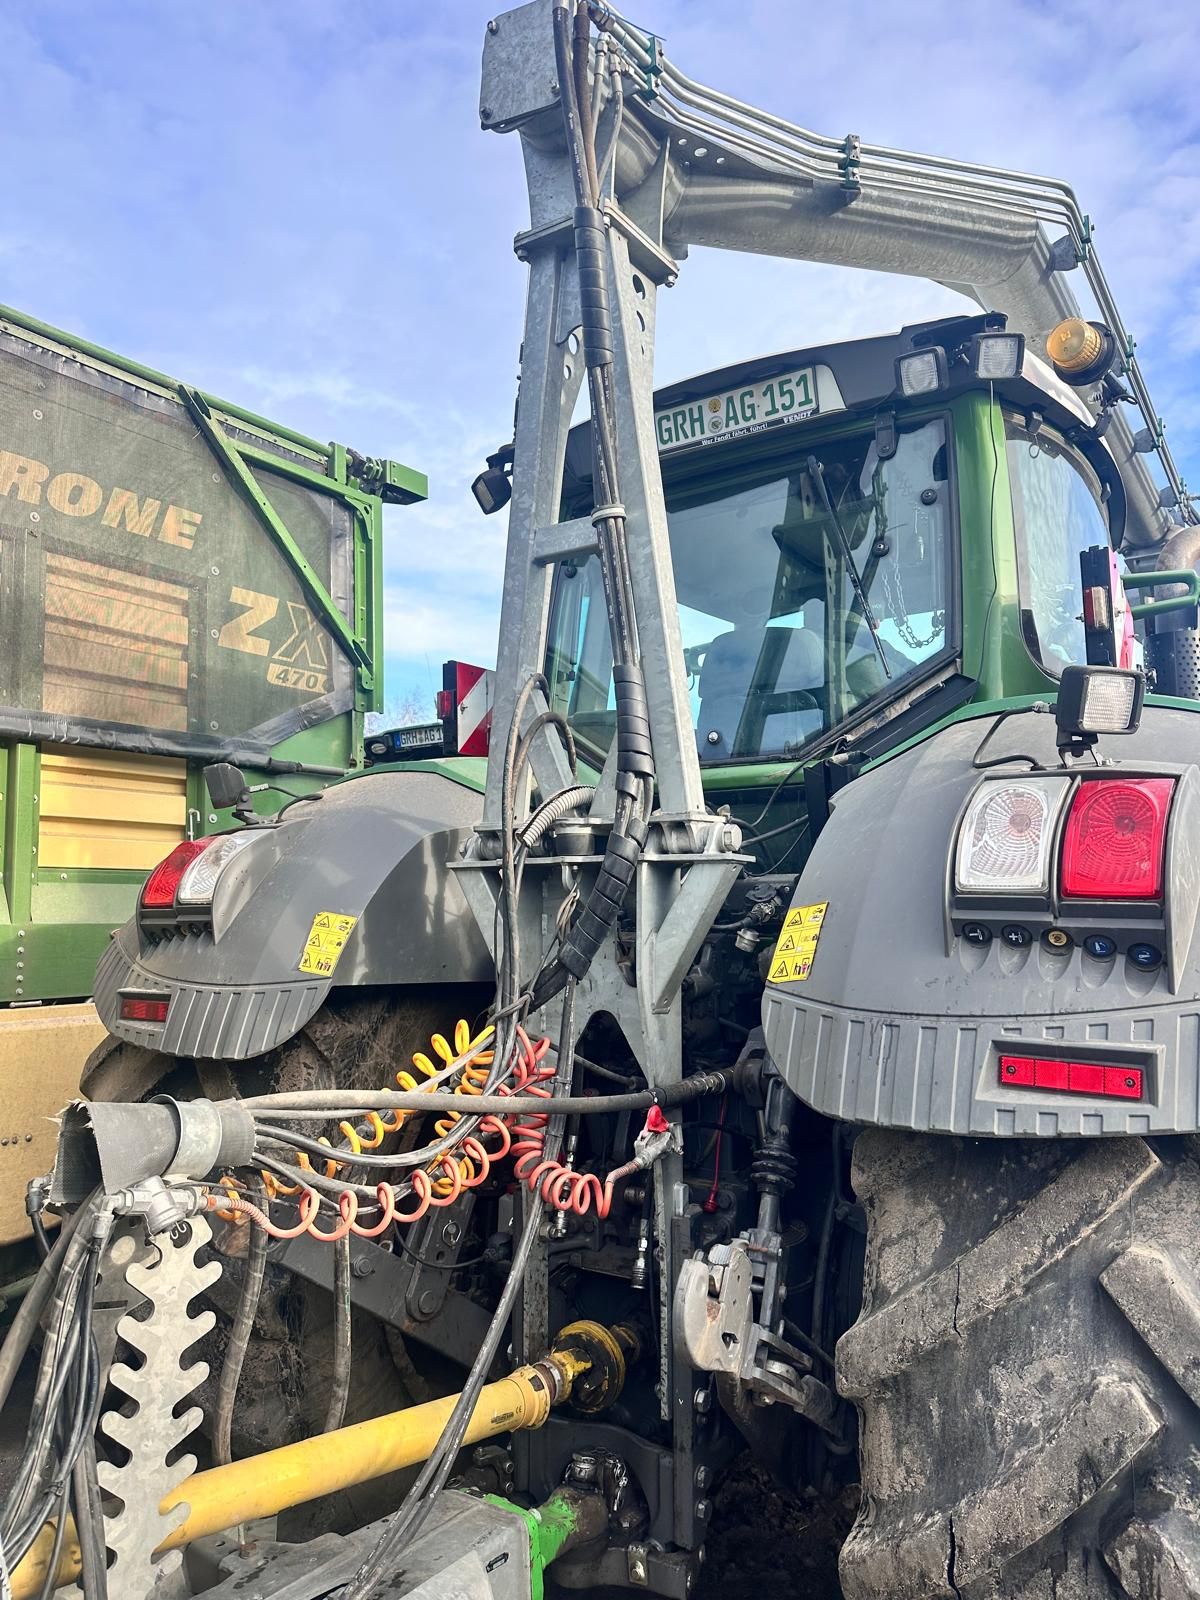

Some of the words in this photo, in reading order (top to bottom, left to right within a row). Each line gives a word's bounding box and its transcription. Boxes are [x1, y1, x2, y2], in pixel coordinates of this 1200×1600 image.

[657, 404, 705, 445] GRH
[724, 389, 757, 428] AG
[762, 373, 814, 417] 151
[783, 410, 813, 424] FENDT
[0, 449, 203, 550] RONE
[218, 586, 328, 670] ZX
[400, 731, 418, 745] GRH
[424, 728, 435, 743] AG
